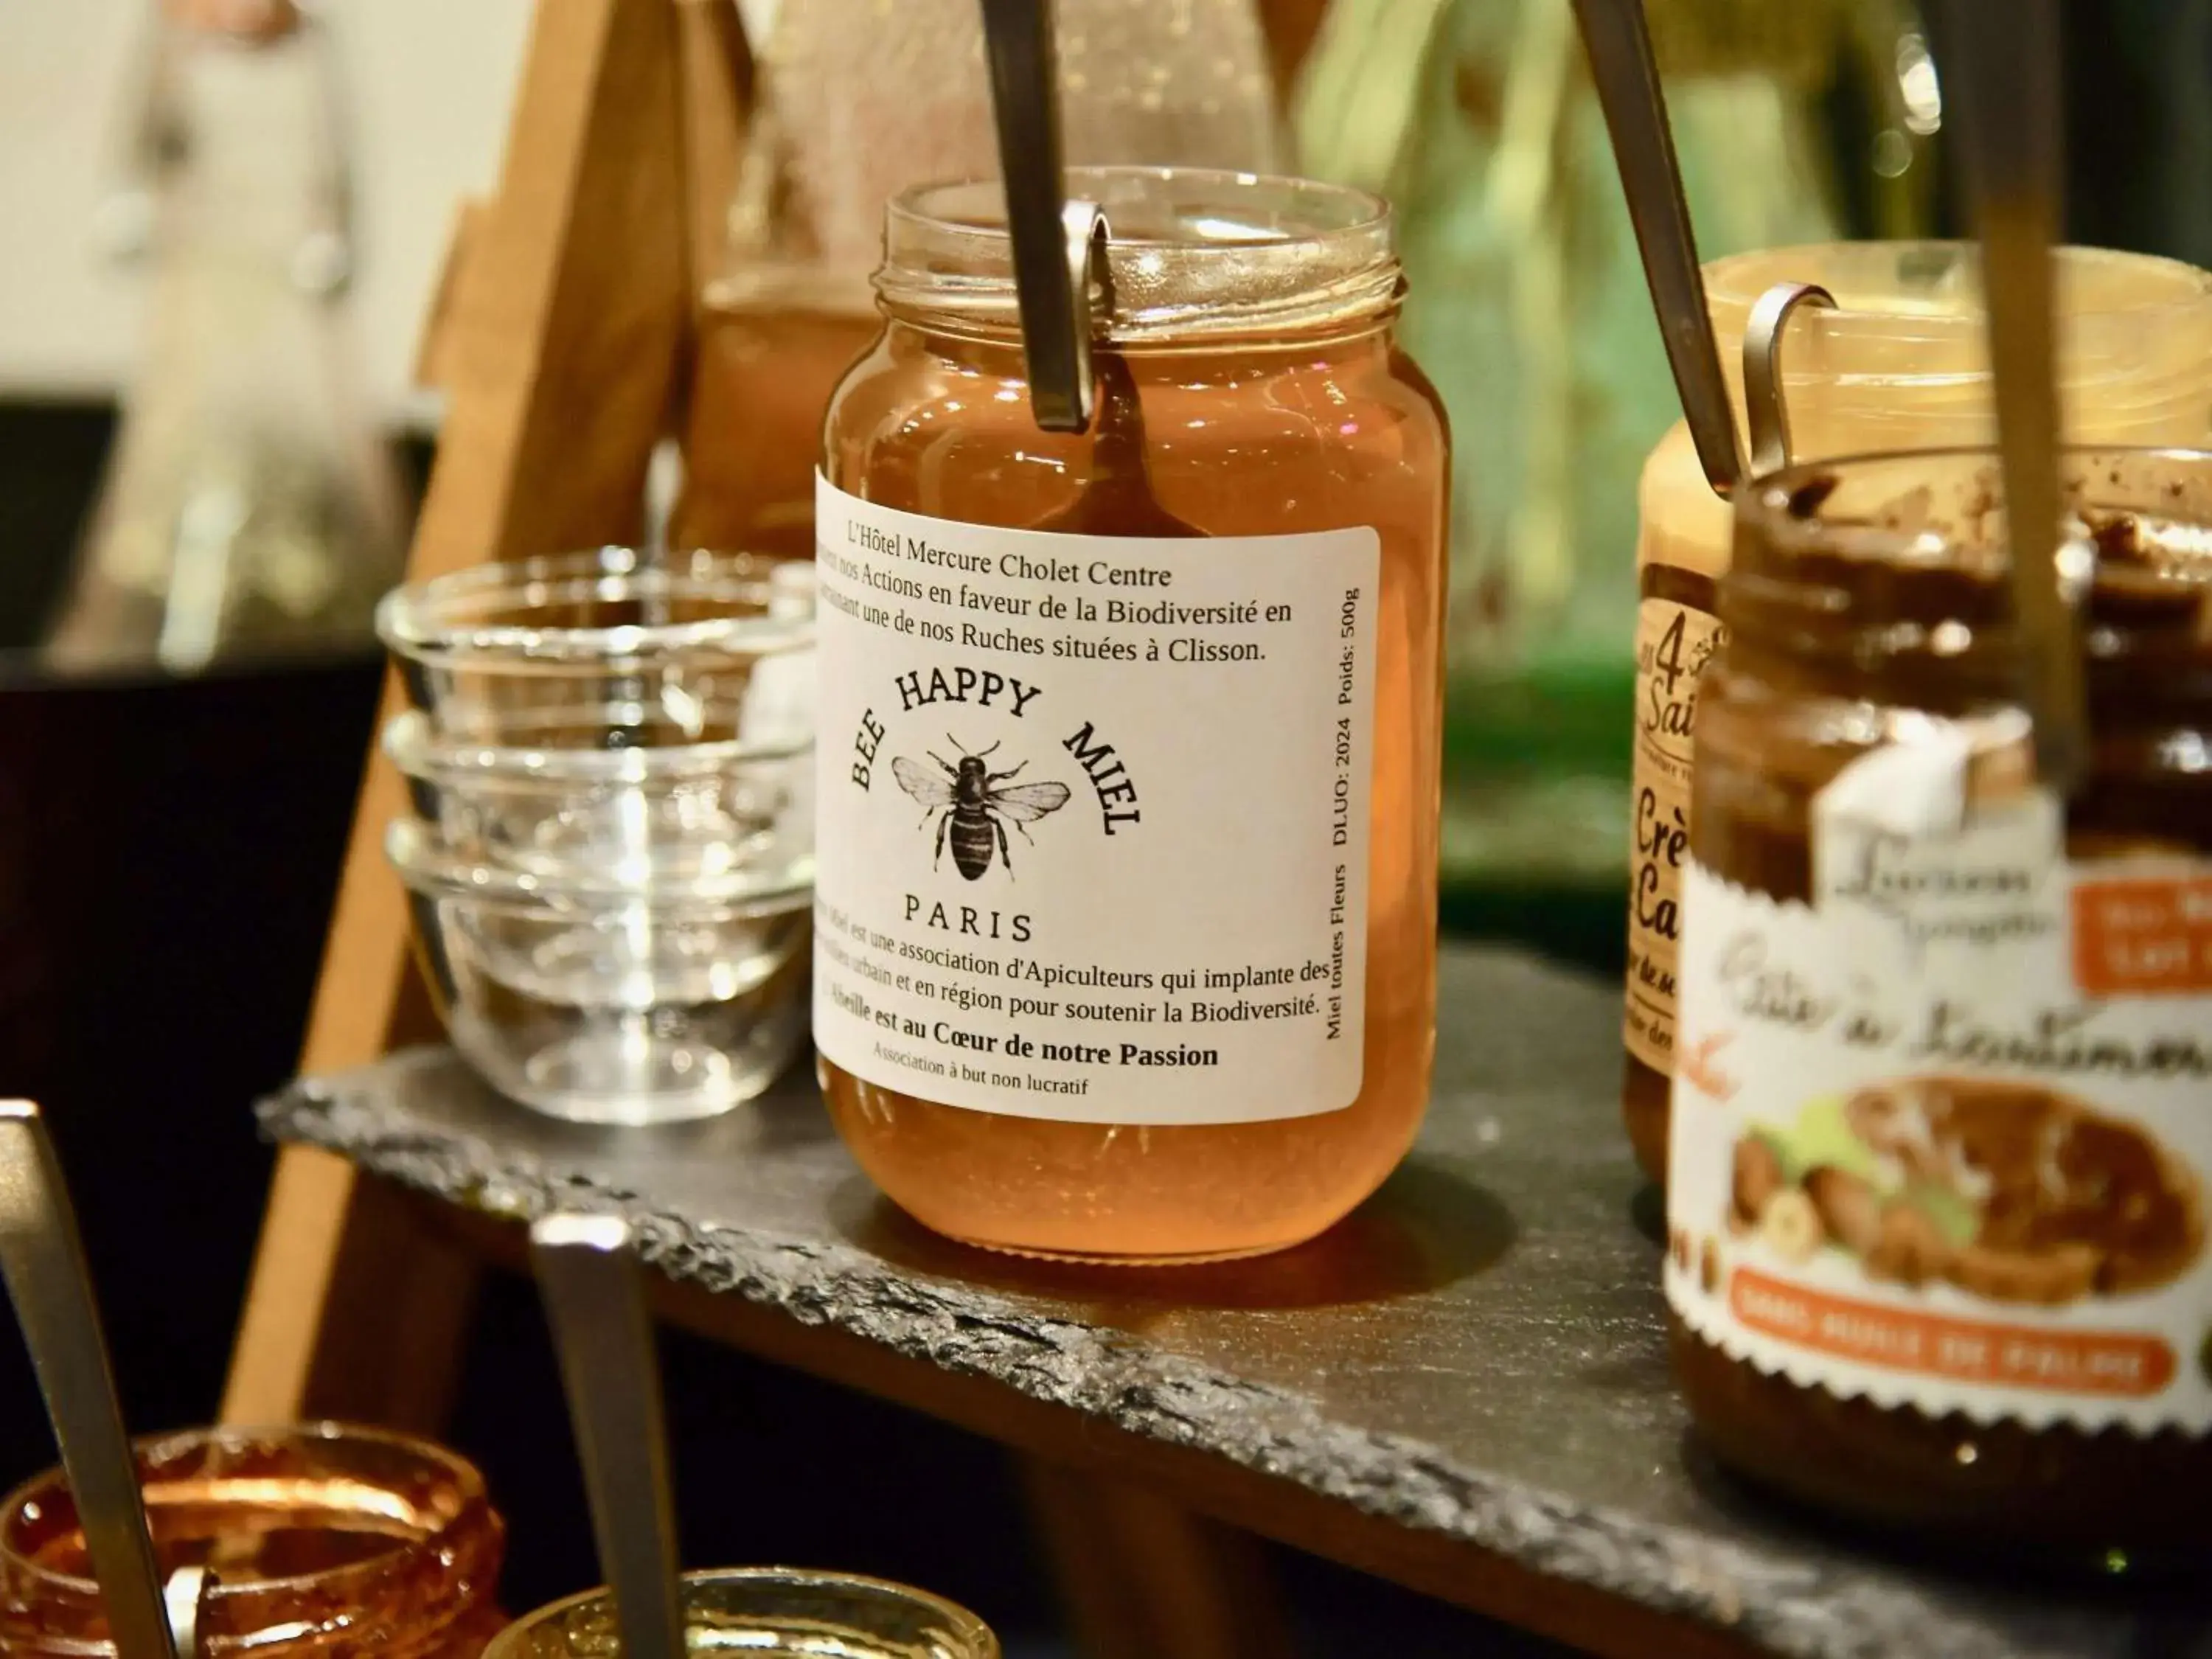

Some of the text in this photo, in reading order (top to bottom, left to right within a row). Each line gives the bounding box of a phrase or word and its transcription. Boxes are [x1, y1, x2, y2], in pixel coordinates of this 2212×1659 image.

[848, 519, 1172, 587] L'Hôtel Mercure Cholet Centre
[862, 563, 923, 599] Actions
[929, 585, 952, 605] en
[959, 583, 1032, 616] faveur
[1038, 594, 1068, 619] de
[1076, 597, 1097, 622] la
[1107, 599, 1258, 625] Biodiversité
[1265, 603, 1293, 622] en
[863, 604, 1267, 662] une de nos Ruches situées à Clisson.
[1656, 610, 1686, 695] 4
[851, 667, 1141, 836] BEE HAPPY MIEL
[1326, 587, 1360, 1041] Miel toutes Fleurs DLUO: 2024 Poids: 500g
[905, 894, 1032, 942] PARIS
[870, 934, 895, 953] une
[899, 941, 1000, 976] association
[1006, 959, 1153, 989] d'Apiculteurs
[1161, 968, 1196, 994] qui
[1204, 964, 1295, 993] implante
[1300, 960, 1329, 982] des
[896, 973, 911, 992] et
[915, 981, 936, 998] en
[941, 981, 1002, 1011] région
[1009, 996, 1060, 1019] pour
[1065, 1001, 1157, 1023] soutenir
[1164, 1001, 1183, 1023] la
[1190, 993, 1321, 1023] Biodiversité.
[875, 1009, 898, 1031] est
[903, 1018, 926, 1038] au
[933, 1022, 998, 1052] Cœur
[1005, 1034, 1034, 1058] de
[1040, 1043, 1111, 1064] notre
[1119, 1043, 1219, 1066] Passion
[873, 1041, 1089, 1096] Association à but non lucratif
